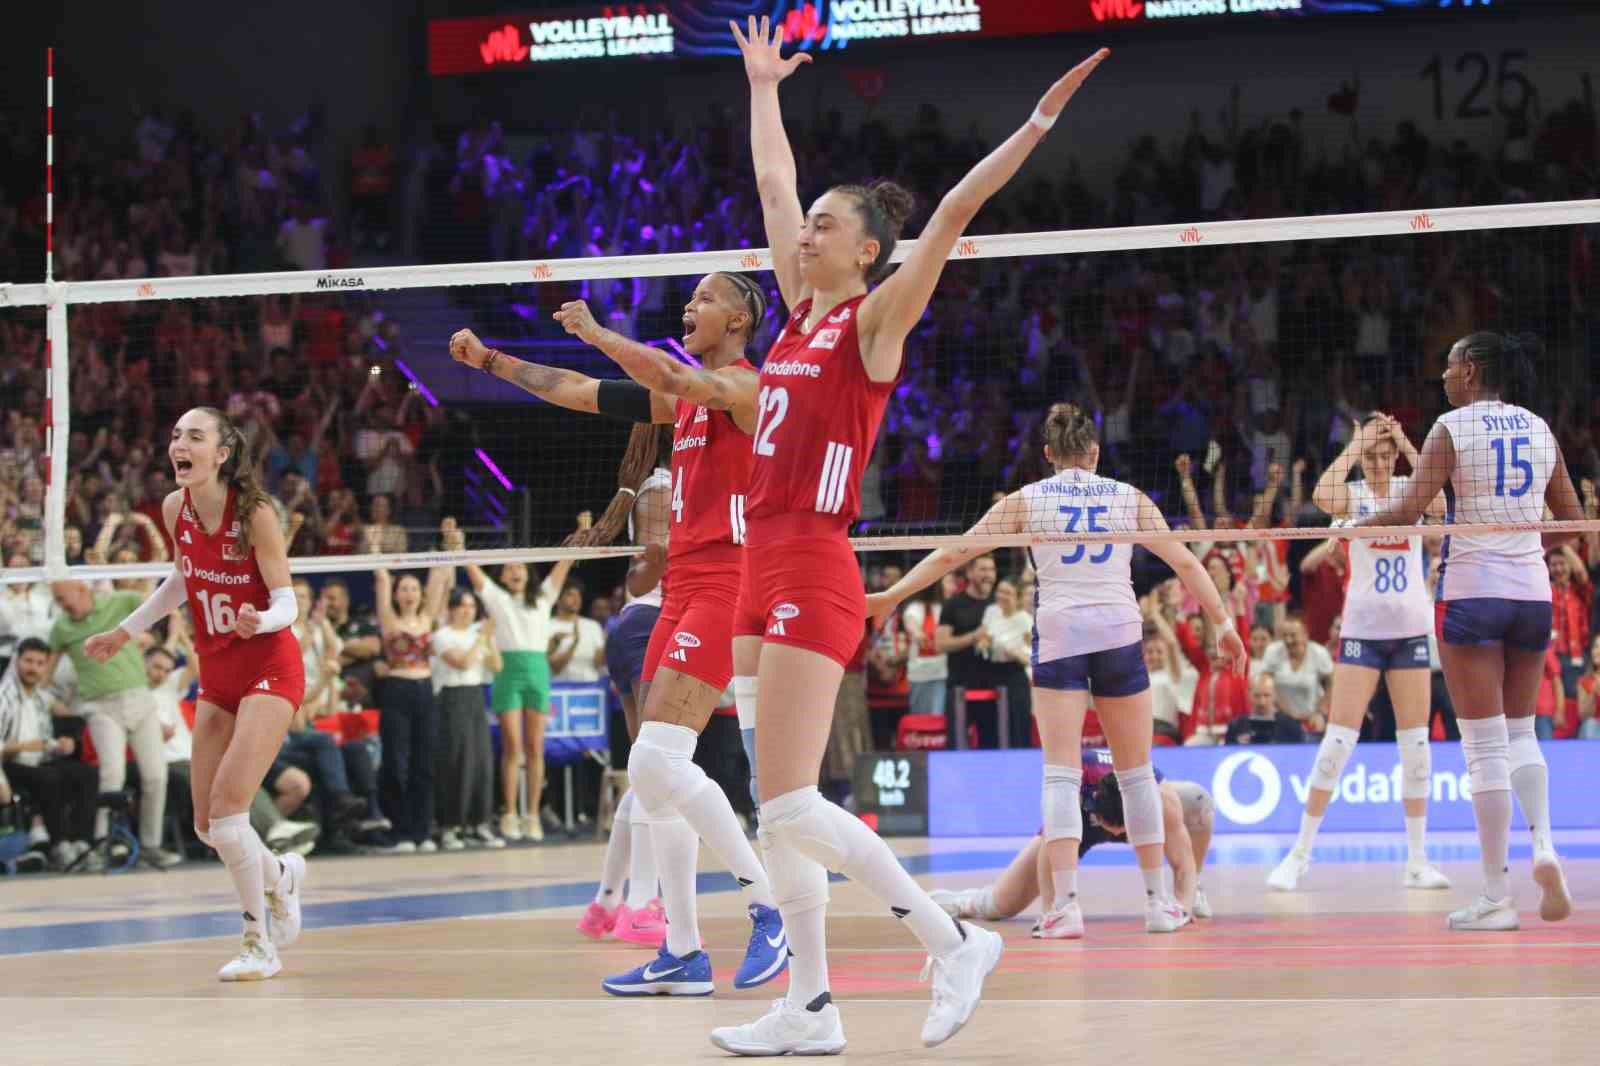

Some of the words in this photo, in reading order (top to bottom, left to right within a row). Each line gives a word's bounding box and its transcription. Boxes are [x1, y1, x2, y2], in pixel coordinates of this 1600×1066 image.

[830, 0, 980, 21] VOLLEYBALL
[529, 13, 674, 43] VOLLEYBALL
[831, 20, 909, 39] NATIONS
[911, 14, 981, 35] LEAGUE
[763, 359, 822, 379] vodafone
[752, 385, 789, 457] 12
[1490, 436, 1533, 497] 15
[1058, 504, 1114, 564] 35
[194, 567, 251, 585] vodafone
[1375, 555, 1408, 593] 88
[196, 589, 238, 636] 16
[1344, 641, 1361, 658] 88
